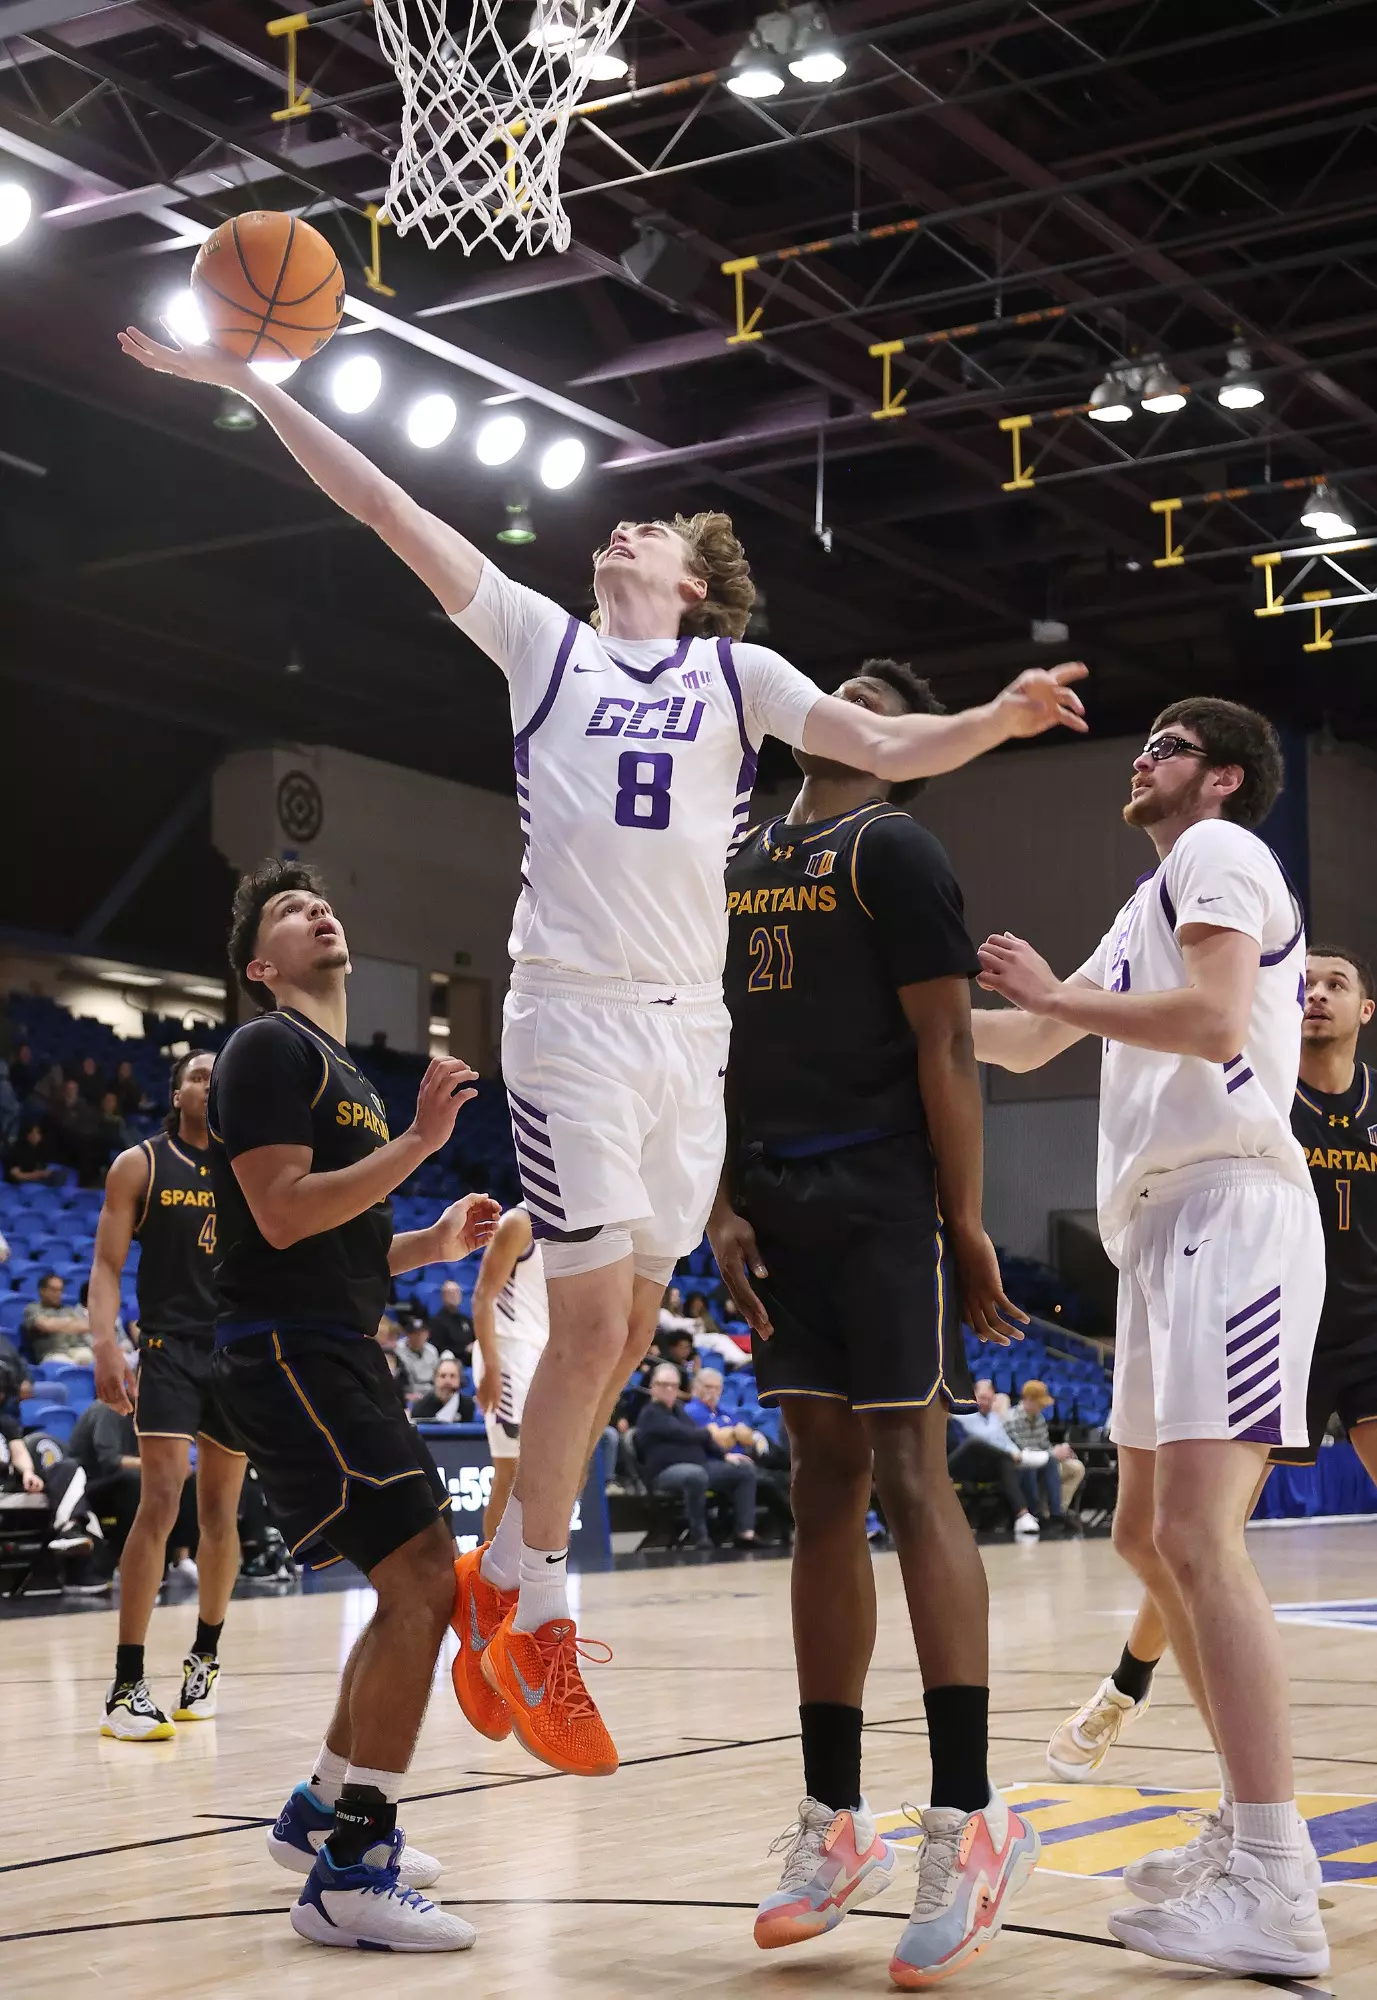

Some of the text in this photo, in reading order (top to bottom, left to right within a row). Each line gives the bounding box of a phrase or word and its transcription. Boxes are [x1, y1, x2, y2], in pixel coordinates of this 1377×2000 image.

[585, 697, 706, 742] GCU
[615, 751, 673, 830] 8
[748, 925, 794, 992] 21
[1336, 1180, 1351, 1230] 1
[198, 1213, 217, 1254] 4
